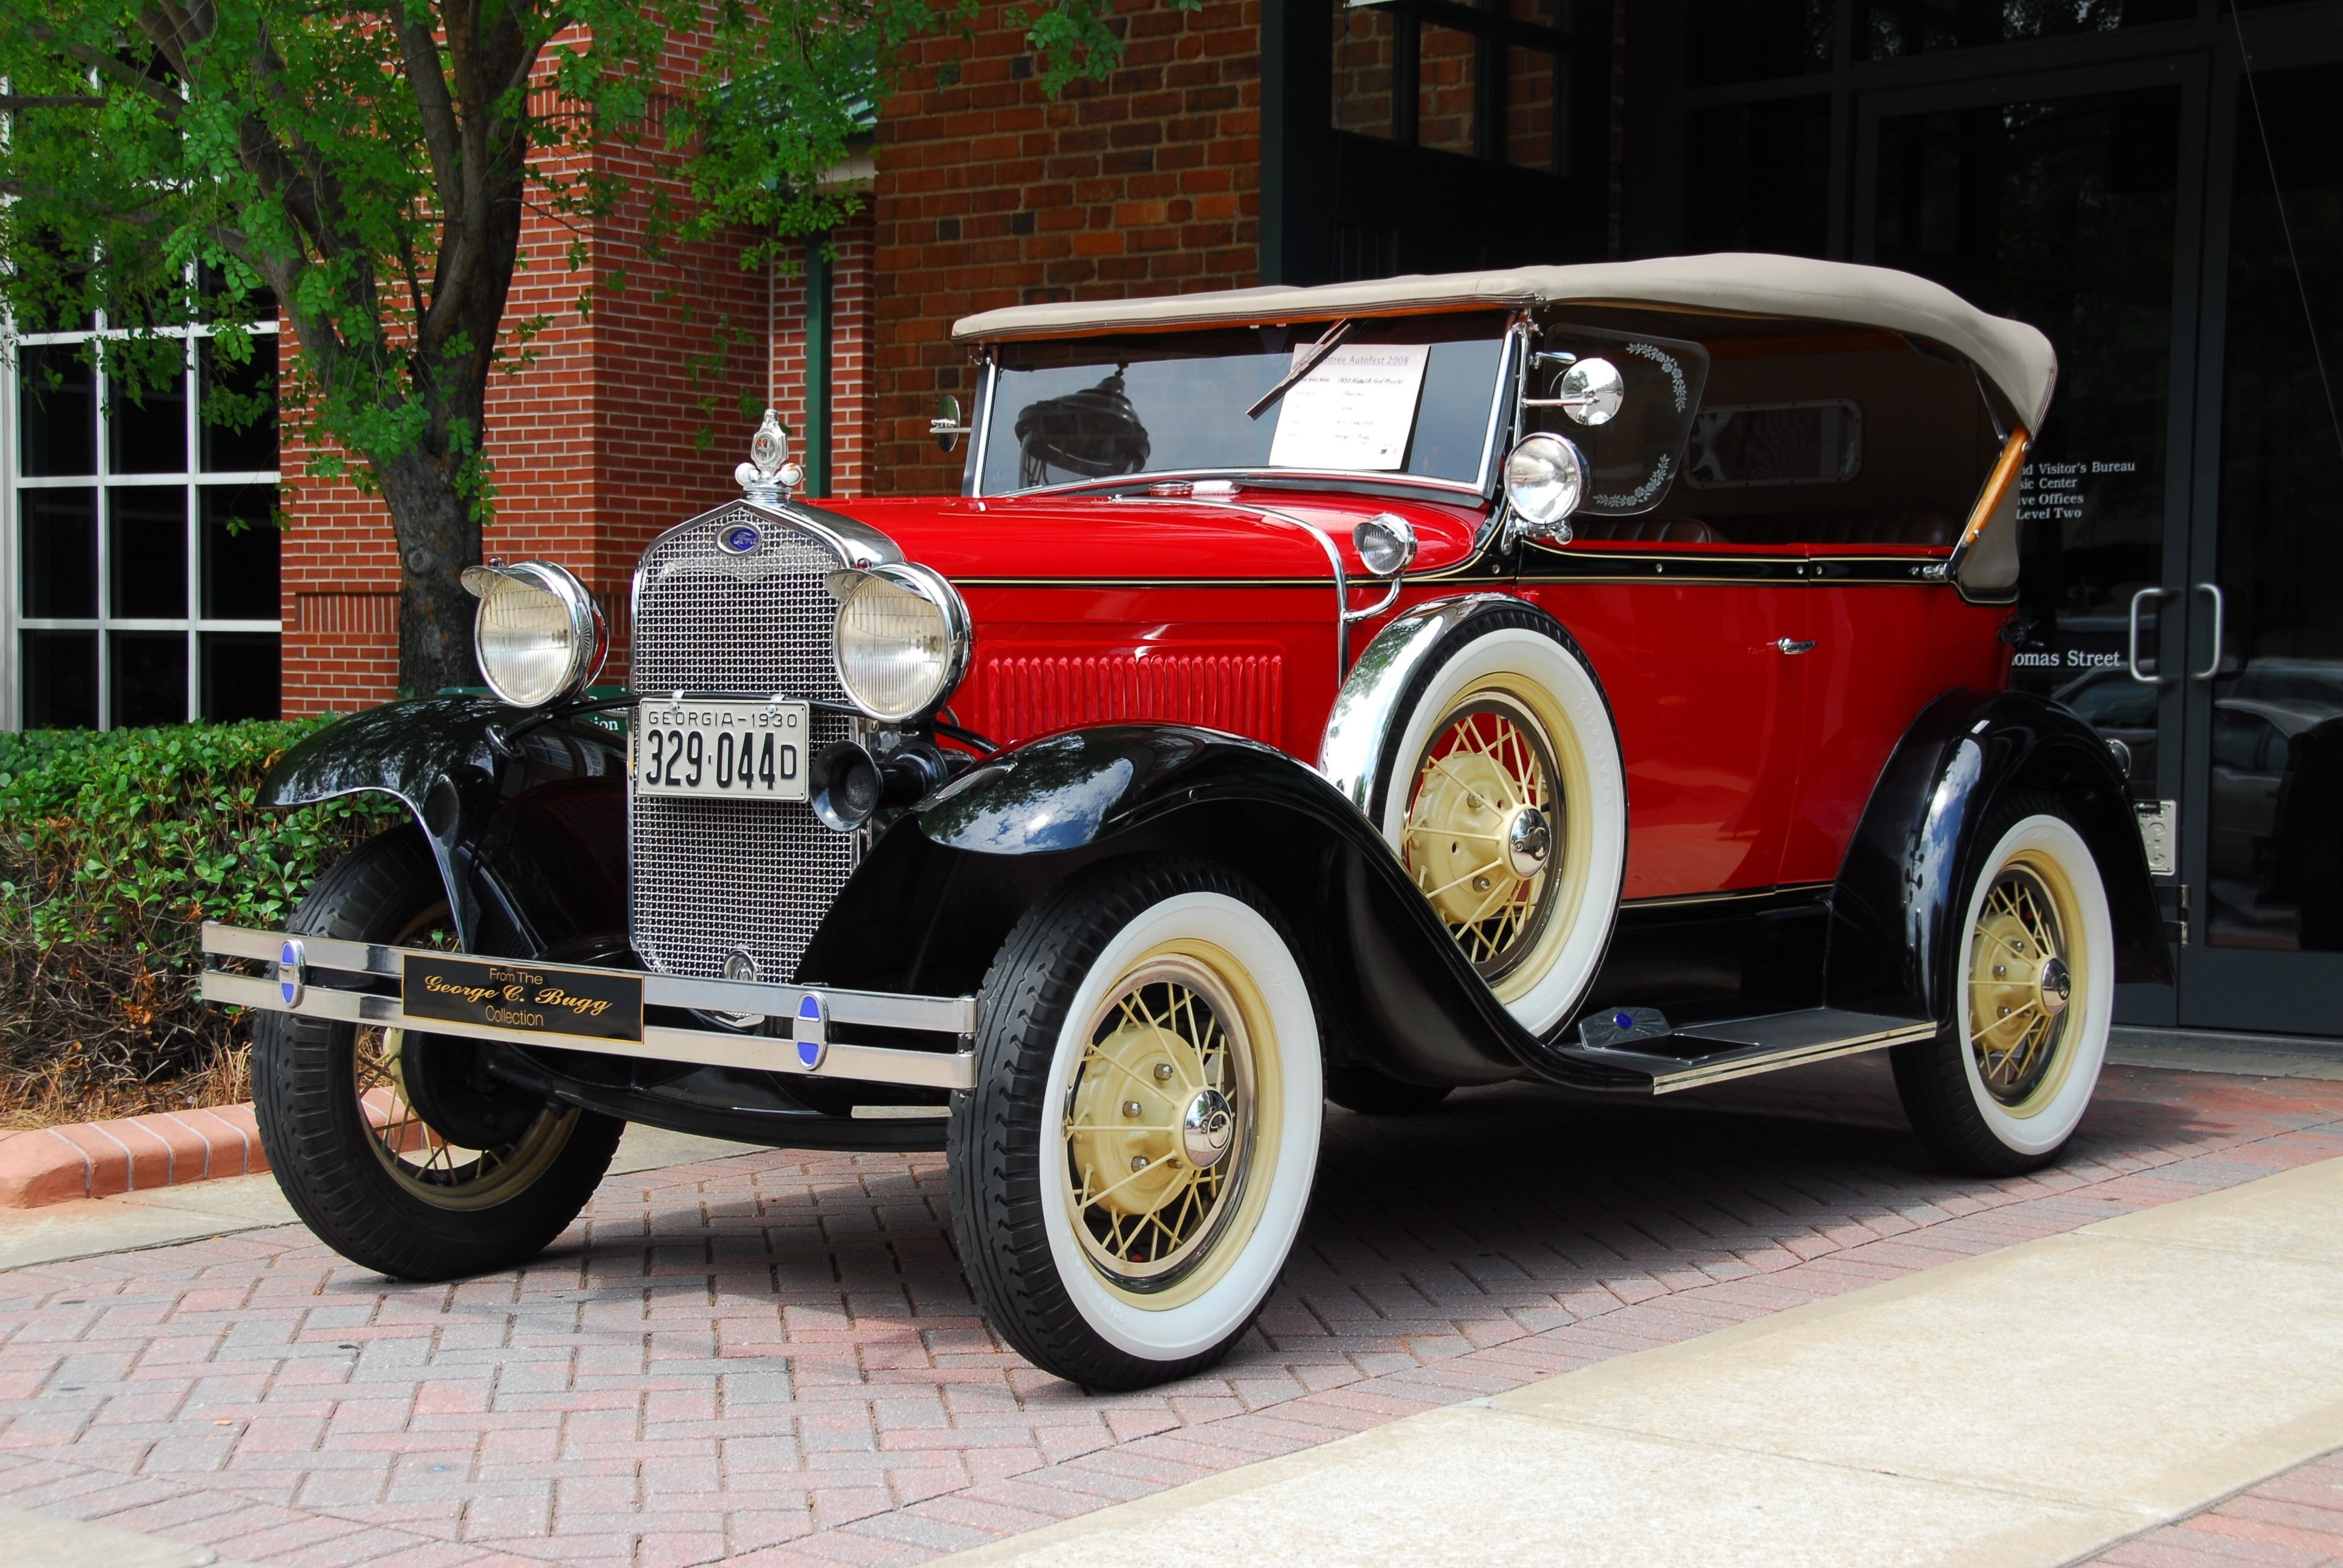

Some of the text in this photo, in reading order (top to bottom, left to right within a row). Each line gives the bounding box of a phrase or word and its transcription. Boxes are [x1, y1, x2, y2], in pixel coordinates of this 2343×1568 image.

[1387, 356, 1409, 364] 2008
[2039, 462, 2086, 475] Visitor's
[2092, 462, 2135, 473] Bureau
[2019, 478, 2078, 489] sic Center
[2039, 493, 2084, 505] Offices
[2016, 507, 2082, 520] Level Two
[2012, 648, 2120, 667] omas Street
[490, 968, 543, 985] From The
[425, 975, 613, 1016] George C. Bugg
[485, 1005, 544, 1027] Collection
